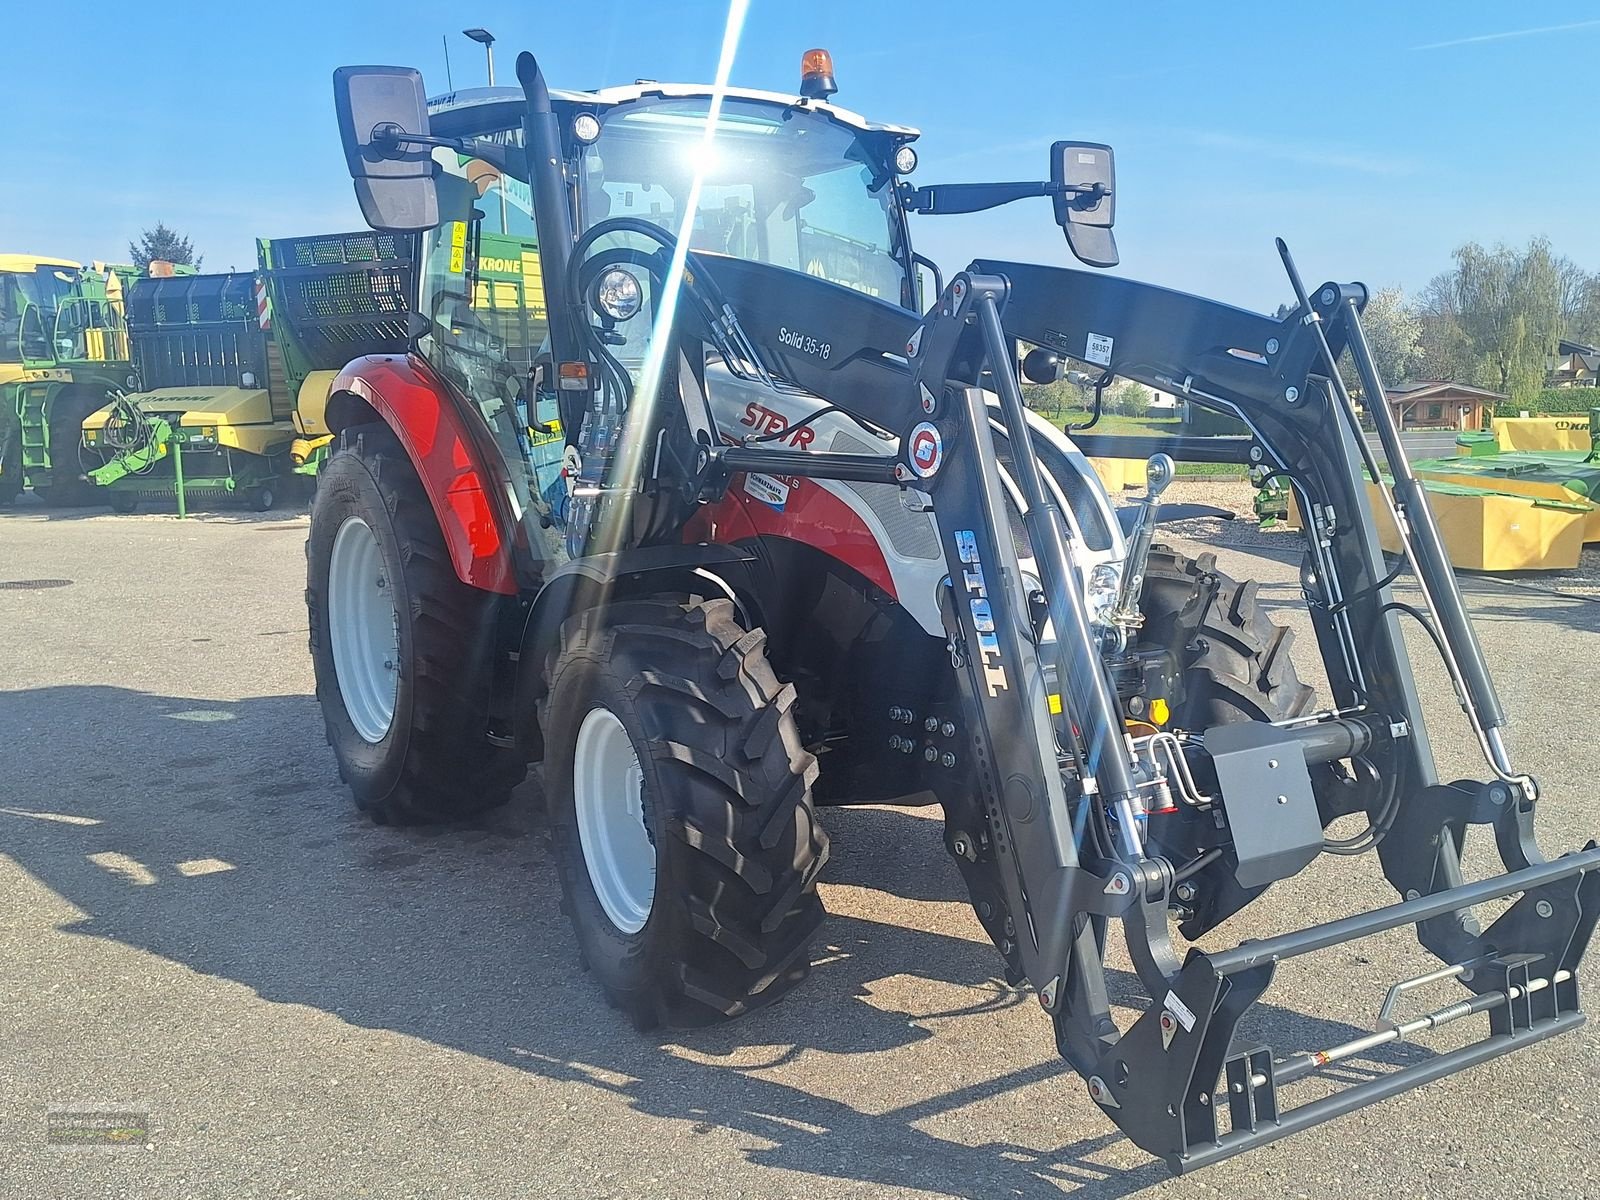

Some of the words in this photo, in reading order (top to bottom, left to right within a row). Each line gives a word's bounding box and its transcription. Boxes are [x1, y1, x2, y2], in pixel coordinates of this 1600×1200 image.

[479, 256, 521, 273] KRONE
[779, 327, 804, 349] Solid
[803, 337, 831, 360] 35-18
[1092, 343, 1110, 353] 58357
[954, 530, 1009, 698] STOLL
